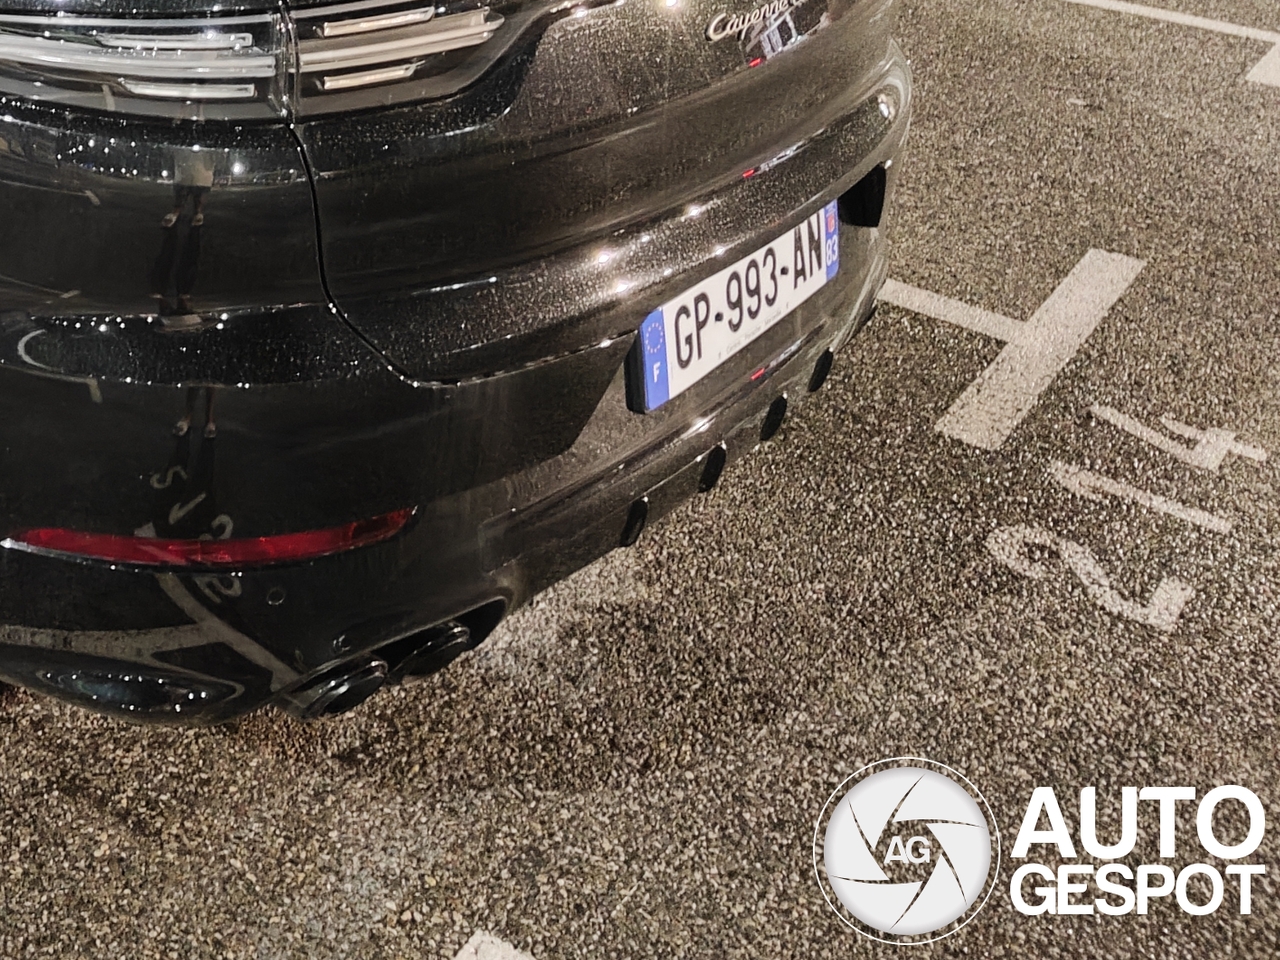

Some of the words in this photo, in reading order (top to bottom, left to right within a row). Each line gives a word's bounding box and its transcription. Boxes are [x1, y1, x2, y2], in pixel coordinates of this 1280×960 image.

[674, 211, 822, 369] GP-993-AN
[825, 234, 839, 267] 83
[652, 361, 661, 383] F
[985, 404, 1267, 632] 214
